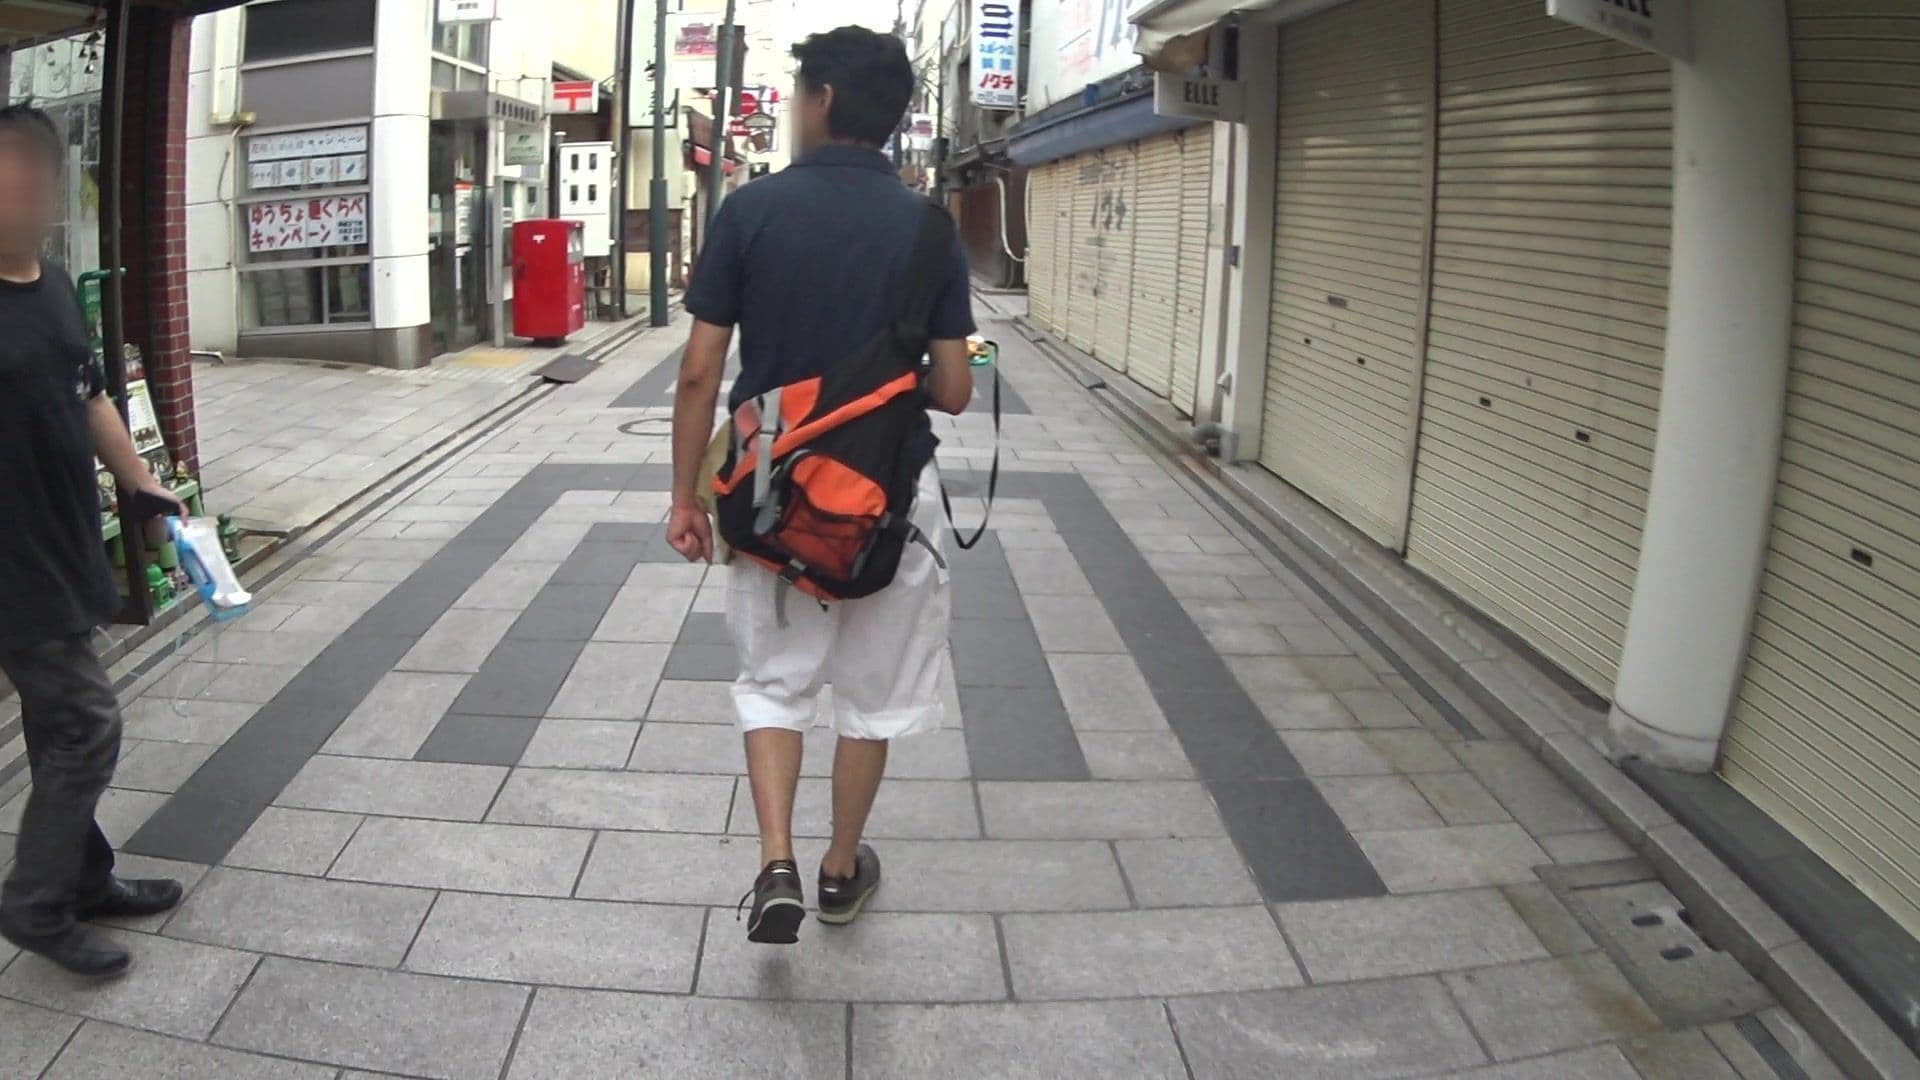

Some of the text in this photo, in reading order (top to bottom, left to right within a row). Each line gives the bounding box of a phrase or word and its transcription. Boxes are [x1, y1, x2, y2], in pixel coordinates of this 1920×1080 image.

[1184, 81, 1219, 106] ELLE
[251, 225, 331, 249] キャンペーン
